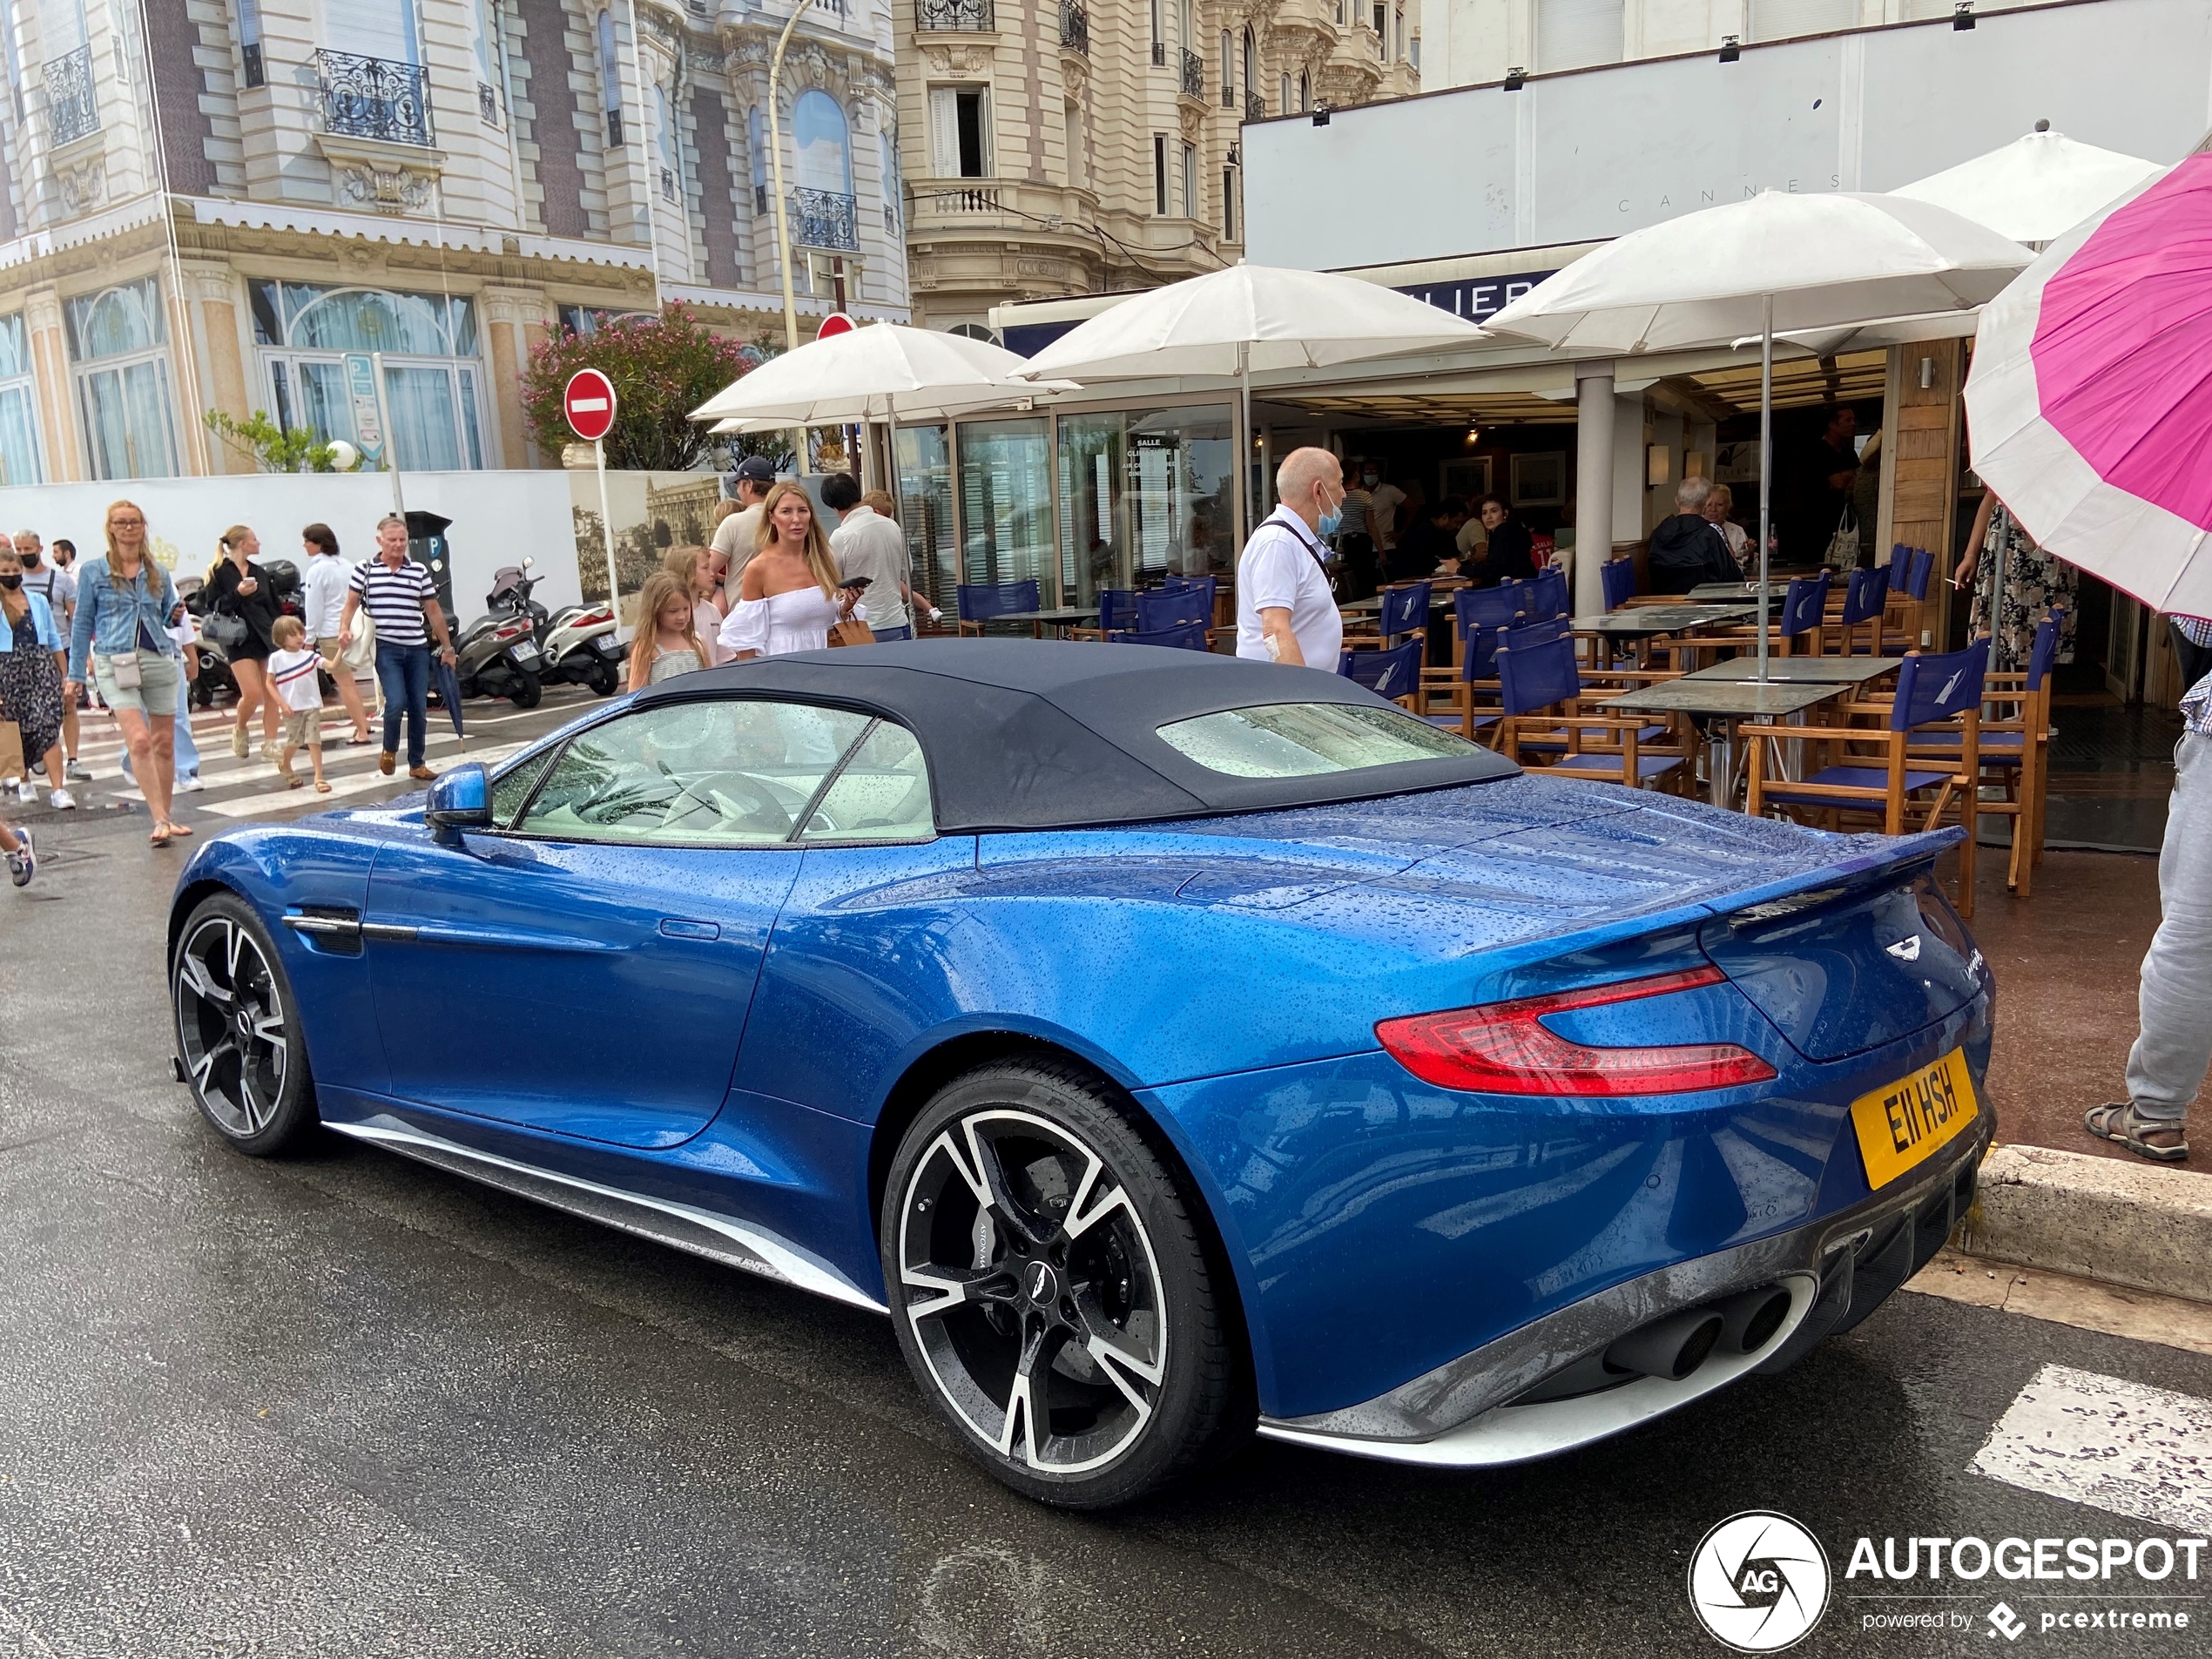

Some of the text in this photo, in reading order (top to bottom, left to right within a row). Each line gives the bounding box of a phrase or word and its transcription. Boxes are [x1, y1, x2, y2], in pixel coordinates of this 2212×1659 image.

[1618, 174, 1840, 212] CANNES
[1408, 280, 1534, 316] IER
[430, 537, 438, 554] P
[1915, 1062, 1959, 1135] HSH
[1068, 1109, 1141, 1179] ZERO
